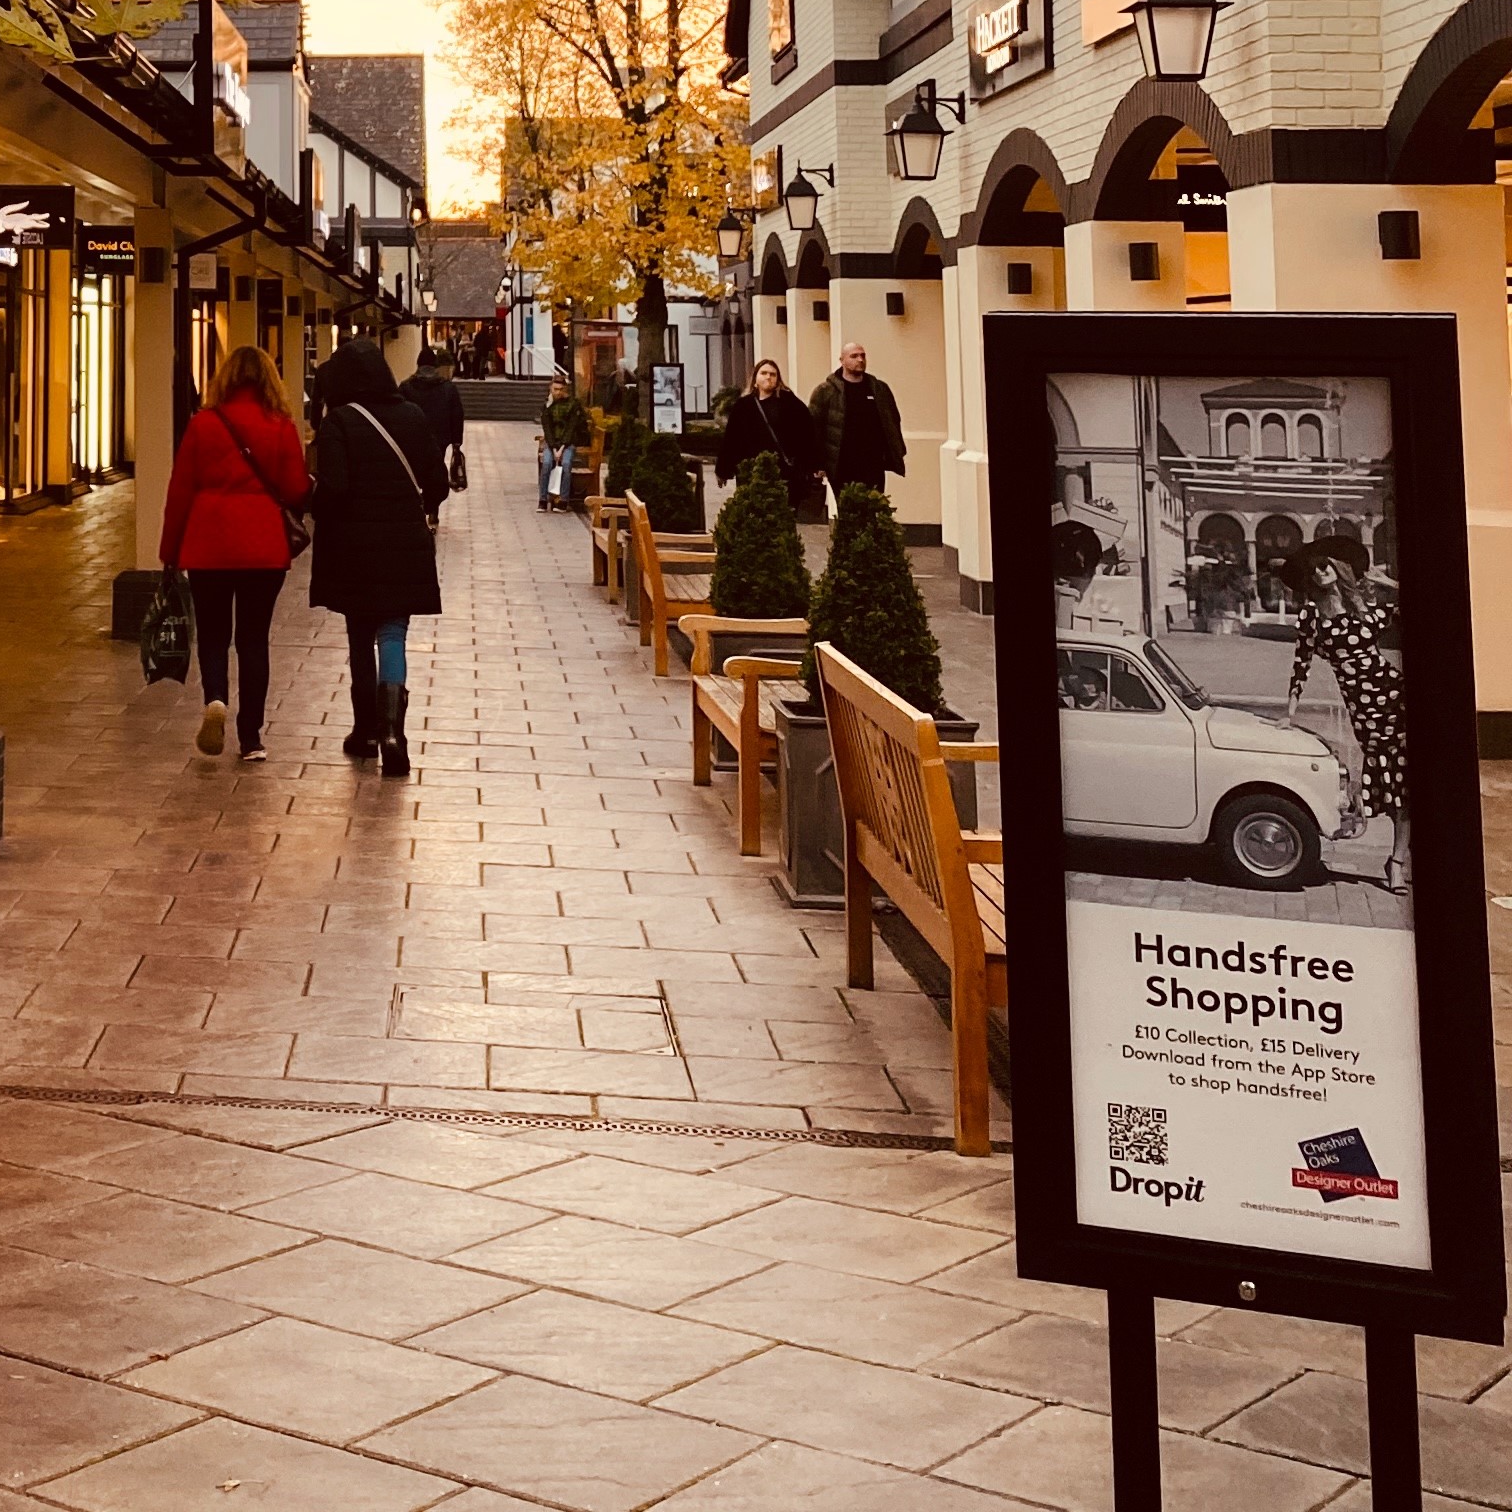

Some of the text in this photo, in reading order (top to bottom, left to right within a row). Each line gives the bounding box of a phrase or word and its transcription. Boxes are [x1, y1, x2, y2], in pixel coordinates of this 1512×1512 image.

[87, 240, 118, 251] David
[1134, 931, 1355, 983] Handsfree
[1146, 975, 1343, 1035] Shopping
[1135, 1024, 1360, 1065] £10 Collection, £15 Delivery
[1122, 1044, 1376, 1086] Download from the App Store
[1168, 1073, 1327, 1102] to shop handsfree!
[1303, 1135, 1356, 1156] Cheshire
[1308, 1153, 1340, 1169] Oaks
[1109, 1165, 1206, 1207] Dropit
[1296, 1170, 1394, 1195] Designer Outlet
